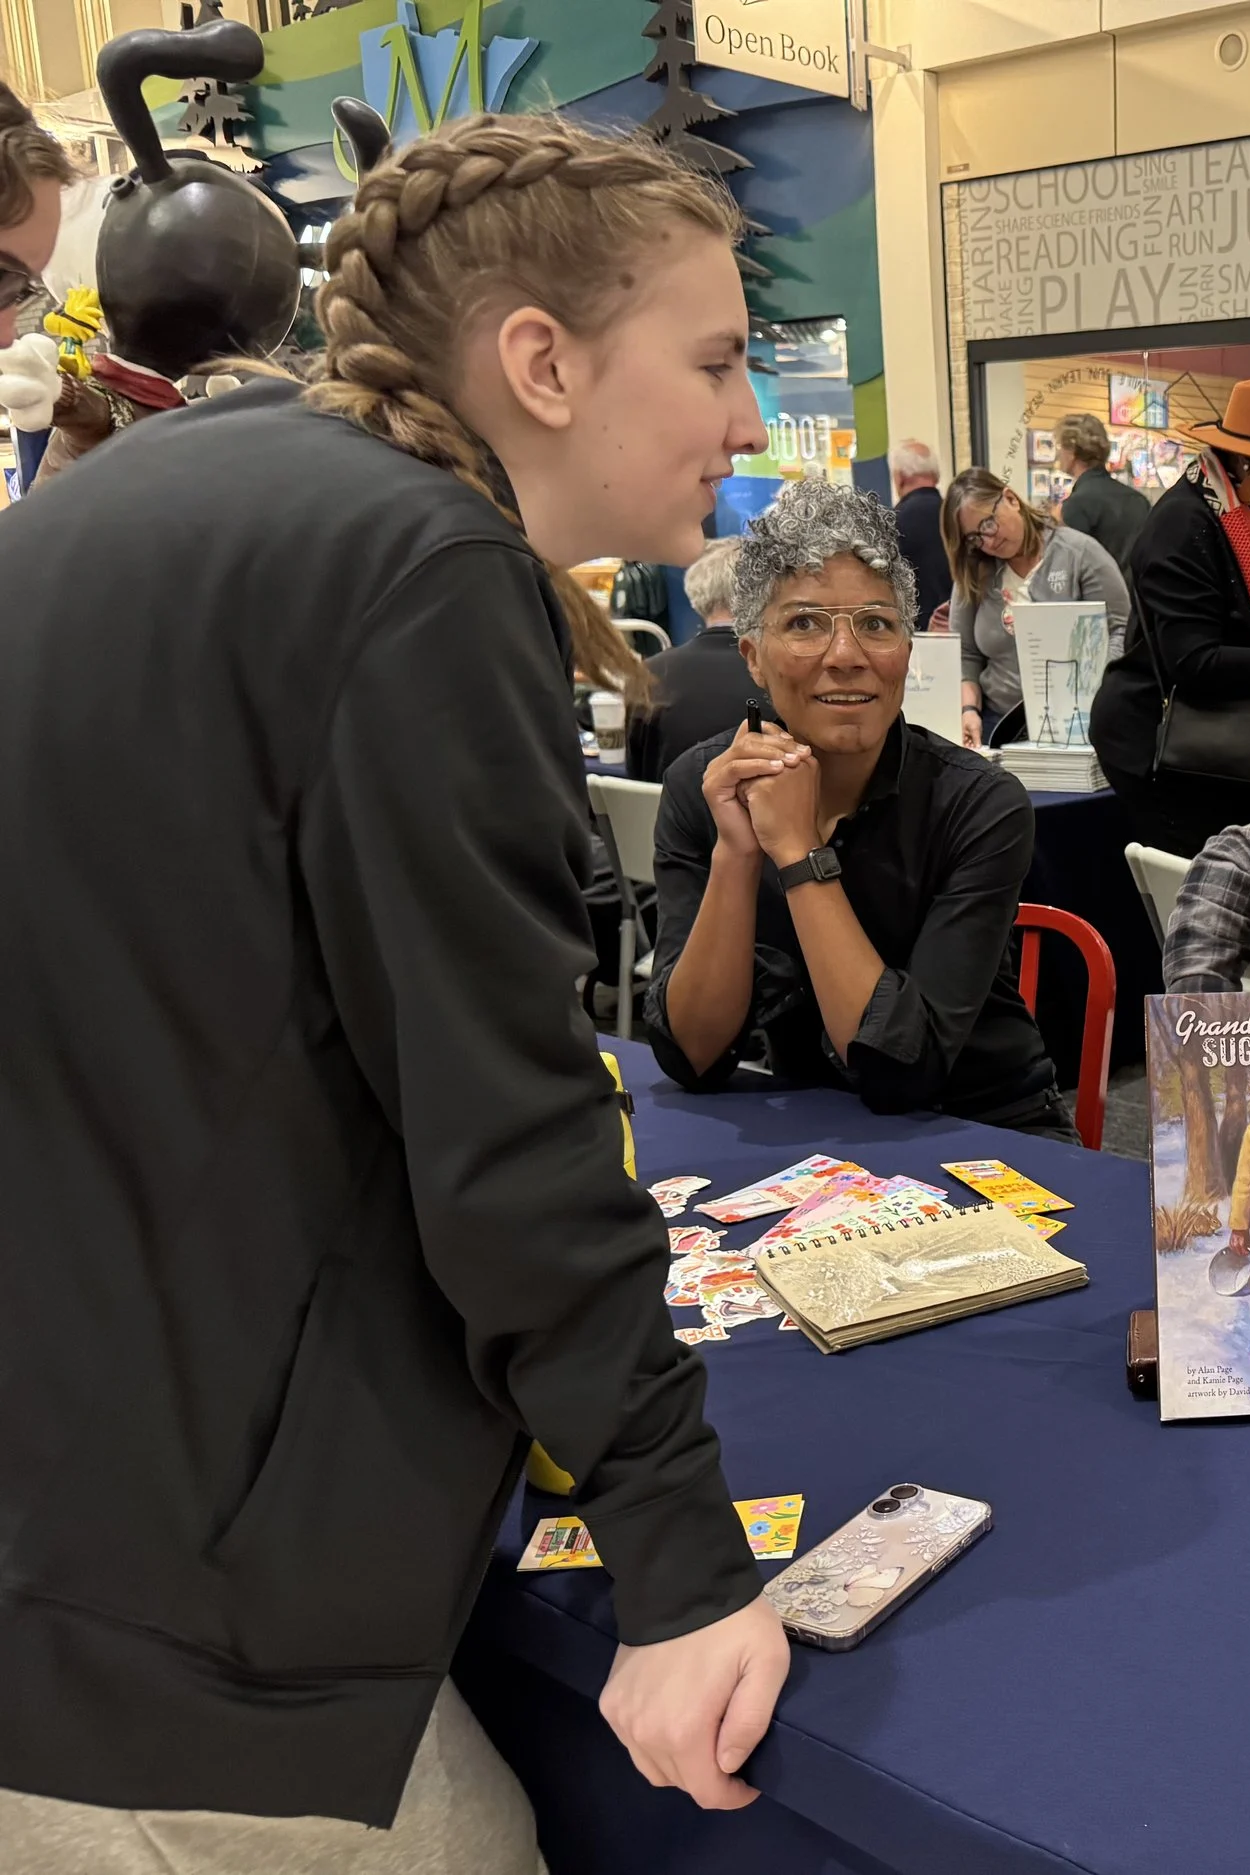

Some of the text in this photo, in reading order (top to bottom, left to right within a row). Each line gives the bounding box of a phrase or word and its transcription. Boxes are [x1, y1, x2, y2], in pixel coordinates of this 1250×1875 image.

[705, 14, 840, 74] Open Book
[1133, 153, 1176, 178] SING
[993, 160, 1141, 214] SCHOOL
[1142, 175, 1178, 194] SMILE
[995, 204, 1141, 236] SHARE SCIENCE FRIENDS
[1166, 188, 1224, 228] ART
[1143, 195, 1163, 257] FUN
[996, 222, 1138, 275] READING
[1169, 228, 1214, 258] RUN
[1187, 1366, 1232, 1377] by Alan Page
[1187, 1376, 1244, 1385] and Kamie Page
[1188, 1388, 1216, 1398] artwork
[1218, 1388, 1227, 1398] by
[1229, 1387, 1250, 1396] David
